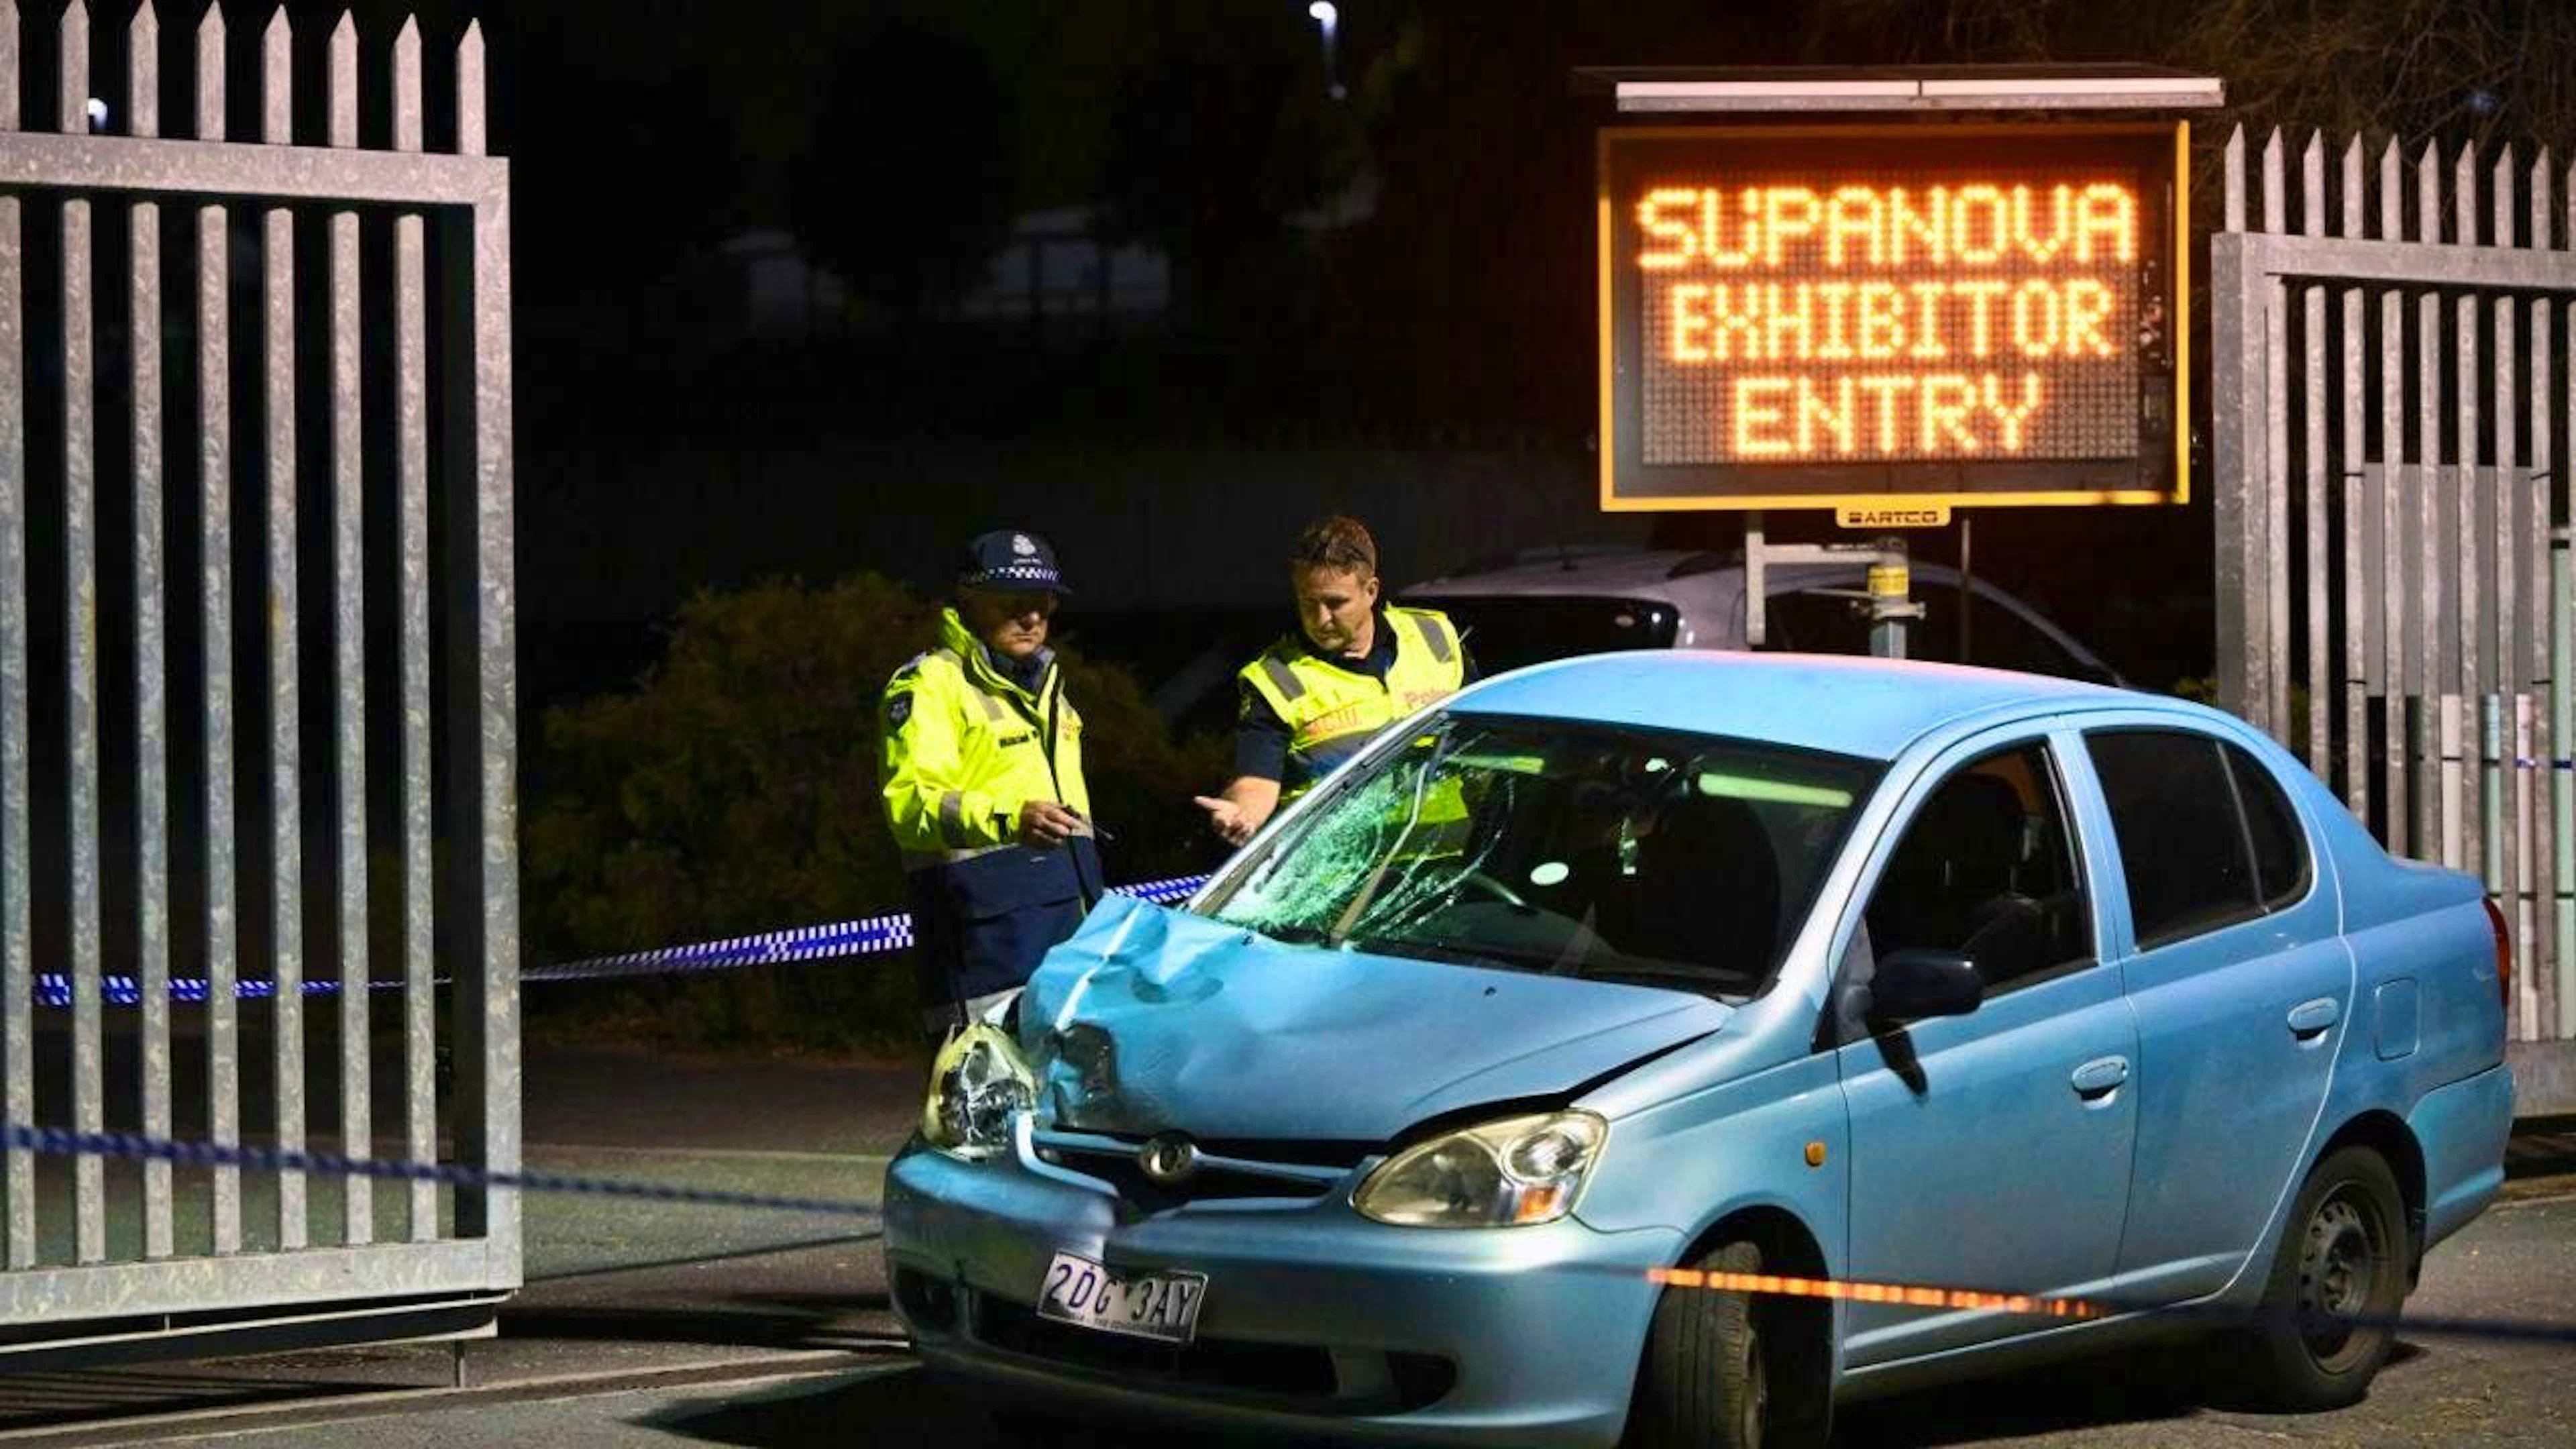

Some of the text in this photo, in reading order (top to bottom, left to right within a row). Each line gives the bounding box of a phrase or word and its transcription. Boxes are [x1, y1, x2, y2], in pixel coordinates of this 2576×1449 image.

[1635, 184, 2136, 268] SUPANOVA
[1668, 279, 2115, 362] EXHIBITOR
[1733, 373, 2041, 455] ENTRY
[1848, 511, 1938, 523] BARTCO
[1130, 1276, 1201, 1323] 3AY
